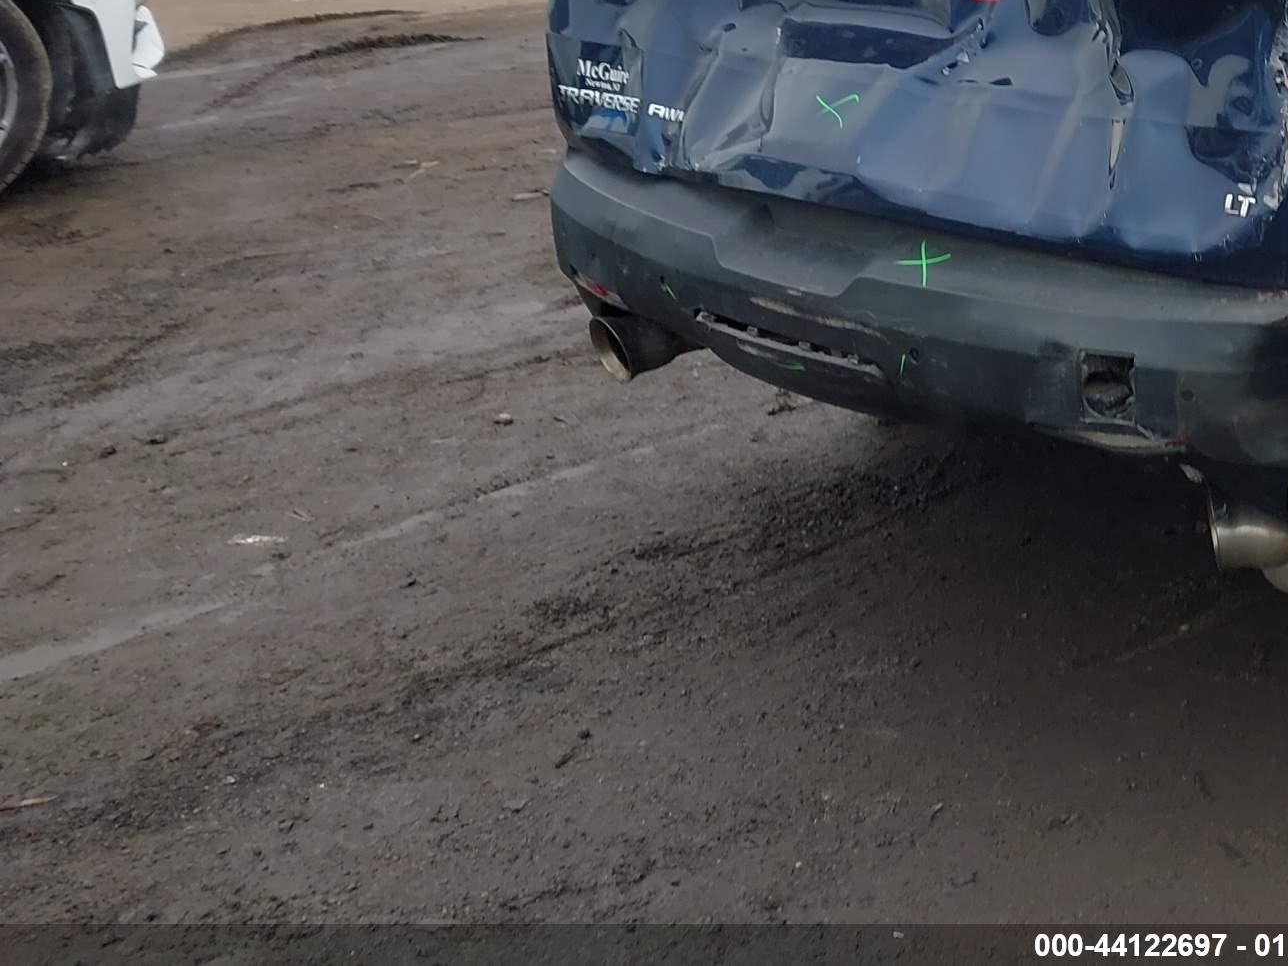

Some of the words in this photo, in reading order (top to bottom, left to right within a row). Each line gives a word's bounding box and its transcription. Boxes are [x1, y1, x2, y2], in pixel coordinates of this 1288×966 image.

[576, 58, 631, 85] McGuire
[557, 84, 641, 114] TRAVERSE
[1224, 193, 1256, 217] LT
